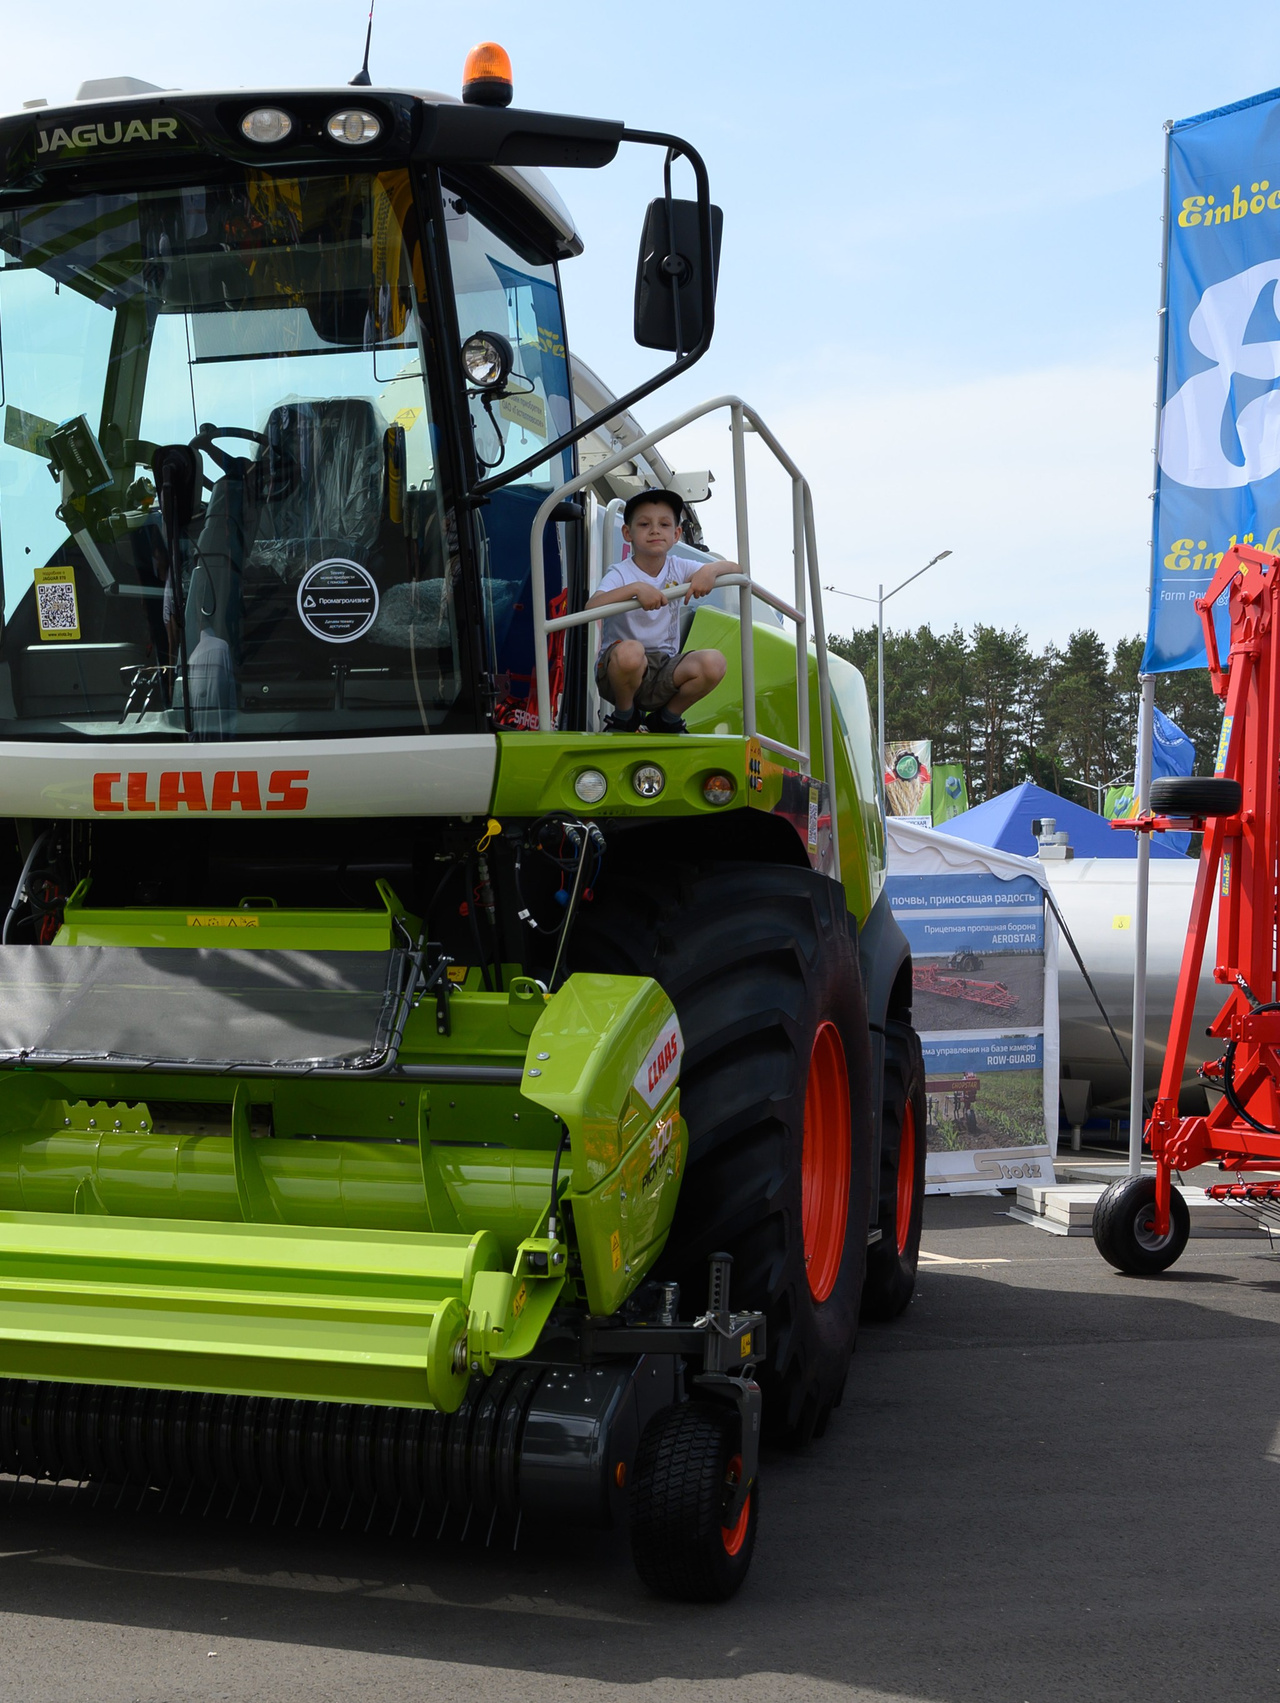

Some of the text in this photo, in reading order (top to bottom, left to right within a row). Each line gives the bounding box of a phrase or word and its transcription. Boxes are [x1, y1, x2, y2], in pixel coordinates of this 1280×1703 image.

[36, 117, 178, 155] JAGUAR
[318, 597, 371, 605] Промагролизинг
[1160, 590, 1186, 601] Farm
[92, 769, 310, 813] CLAAS
[892, 893, 1036, 906] почвы, приносящая радость
[924, 922, 1036, 934] Прицепная пропашная борона
[992, 933, 1036, 944] AEROSTAR
[936, 1046, 980, 1057] управления
[990, 1044, 1008, 1052] базе
[1009, 1044, 1037, 1052] камеры
[647, 1032, 678, 1094] CLAAS
[987, 1054, 1036, 1066] ROW-GUARD
[649, 1117, 673, 1168] 300
[642, 1164, 658, 1195] PICK
